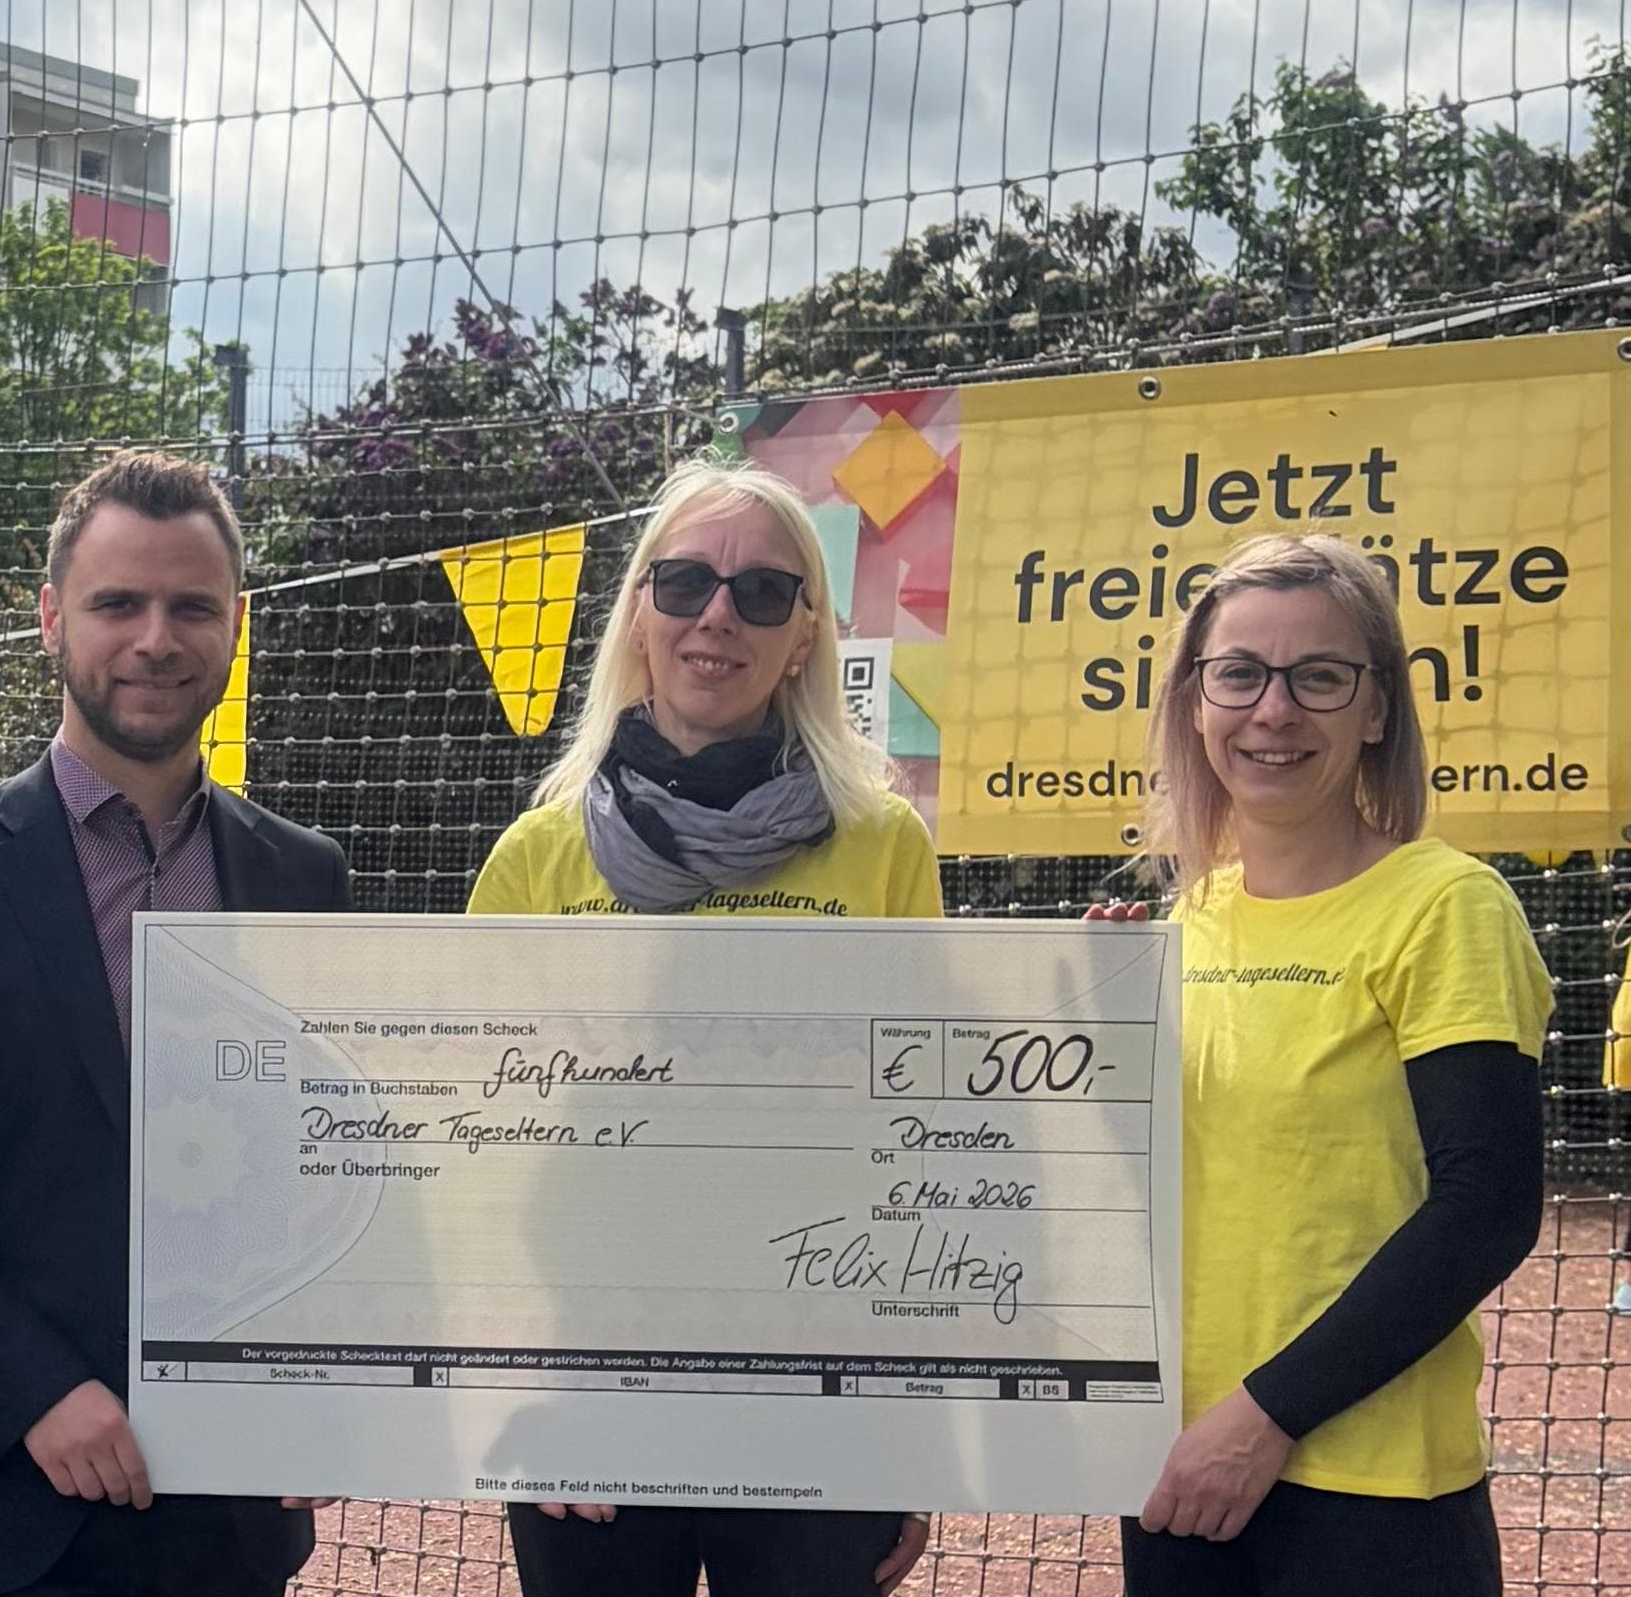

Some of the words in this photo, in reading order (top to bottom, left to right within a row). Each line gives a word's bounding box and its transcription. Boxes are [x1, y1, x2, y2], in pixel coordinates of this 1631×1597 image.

[1152, 446, 1397, 529] Jetzt
[300, 1020, 349, 1035] Zahlen
[354, 1021, 376, 1035] Sie
[381, 1023, 426, 1038] gegen
[430, 1022, 479, 1036] diesen
[483, 1022, 538, 1037] Scheck
[880, 1027, 932, 1040] Währung
[951, 1028, 991, 1041] Betrag
[215, 1039, 287, 1082] DE
[881, 1044, 923, 1092] €
[967, 1028, 1117, 1097] 500,-
[483, 1046, 674, 1099] fünfhundert
[300, 1081, 349, 1098] Betrag
[352, 1081, 366, 1096] in
[370, 1082, 458, 1097] Buchstaben
[300, 1105, 429, 1141] Dresdner
[438, 1110, 579, 1155] Tageseltern
[889, 1115, 1016, 1150] Dresden
[299, 1143, 318, 1155] an
[871, 1150, 896, 1165] Ort
[299, 1162, 338, 1176] oder
[341, 1158, 441, 1180] Überbringer
[912, 1181, 959, 1208] Mai
[967, 1178, 1037, 1210] 2026
[871, 1207, 922, 1222] Datum
[769, 1216, 889, 1290] Felix
[871, 1303, 960, 1318] Unterschrift
[241, 1347, 262, 1360] Der
[265, 1348, 338, 1363] vorgedruckte
[340, 1349, 401, 1363] Schecktext
[404, 1351, 428, 1363] darf
[429, 1351, 458, 1364] nicht
[460, 1352, 510, 1366] geändert
[512, 1353, 539, 1366] oder
[541, 1354, 601, 1368] gestrichen
[602, 1356, 648, 1369] werden.
[650, 1356, 669, 1369] Die
[671, 1357, 716, 1371] Angabe
[718, 1358, 746, 1370] einer
[749, 1358, 823, 1373] Zahlungsfrist
[825, 1360, 844, 1371] auf
[846, 1360, 872, 1373] dem
[874, 1361, 917, 1374] Scheck
[919, 1362, 937, 1376] gilt
[939, 1363, 957, 1375] als
[958, 1363, 988, 1376] nicht
[990, 1364, 1064, 1378] geschrieben.
[269, 1367, 330, 1381] Scheck-Nr.
[620, 1375, 650, 1388] IBAN
[905, 1381, 944, 1396] Betrag
[474, 1477, 507, 1492] Bitte
[511, 1478, 556, 1493] dieses
[560, 1479, 590, 1493] Feld
[593, 1480, 628, 1494] nicht
[631, 1481, 709, 1496] beschriften
[712, 1483, 739, 1497] und
[743, 1484, 823, 1500] bestempeln
